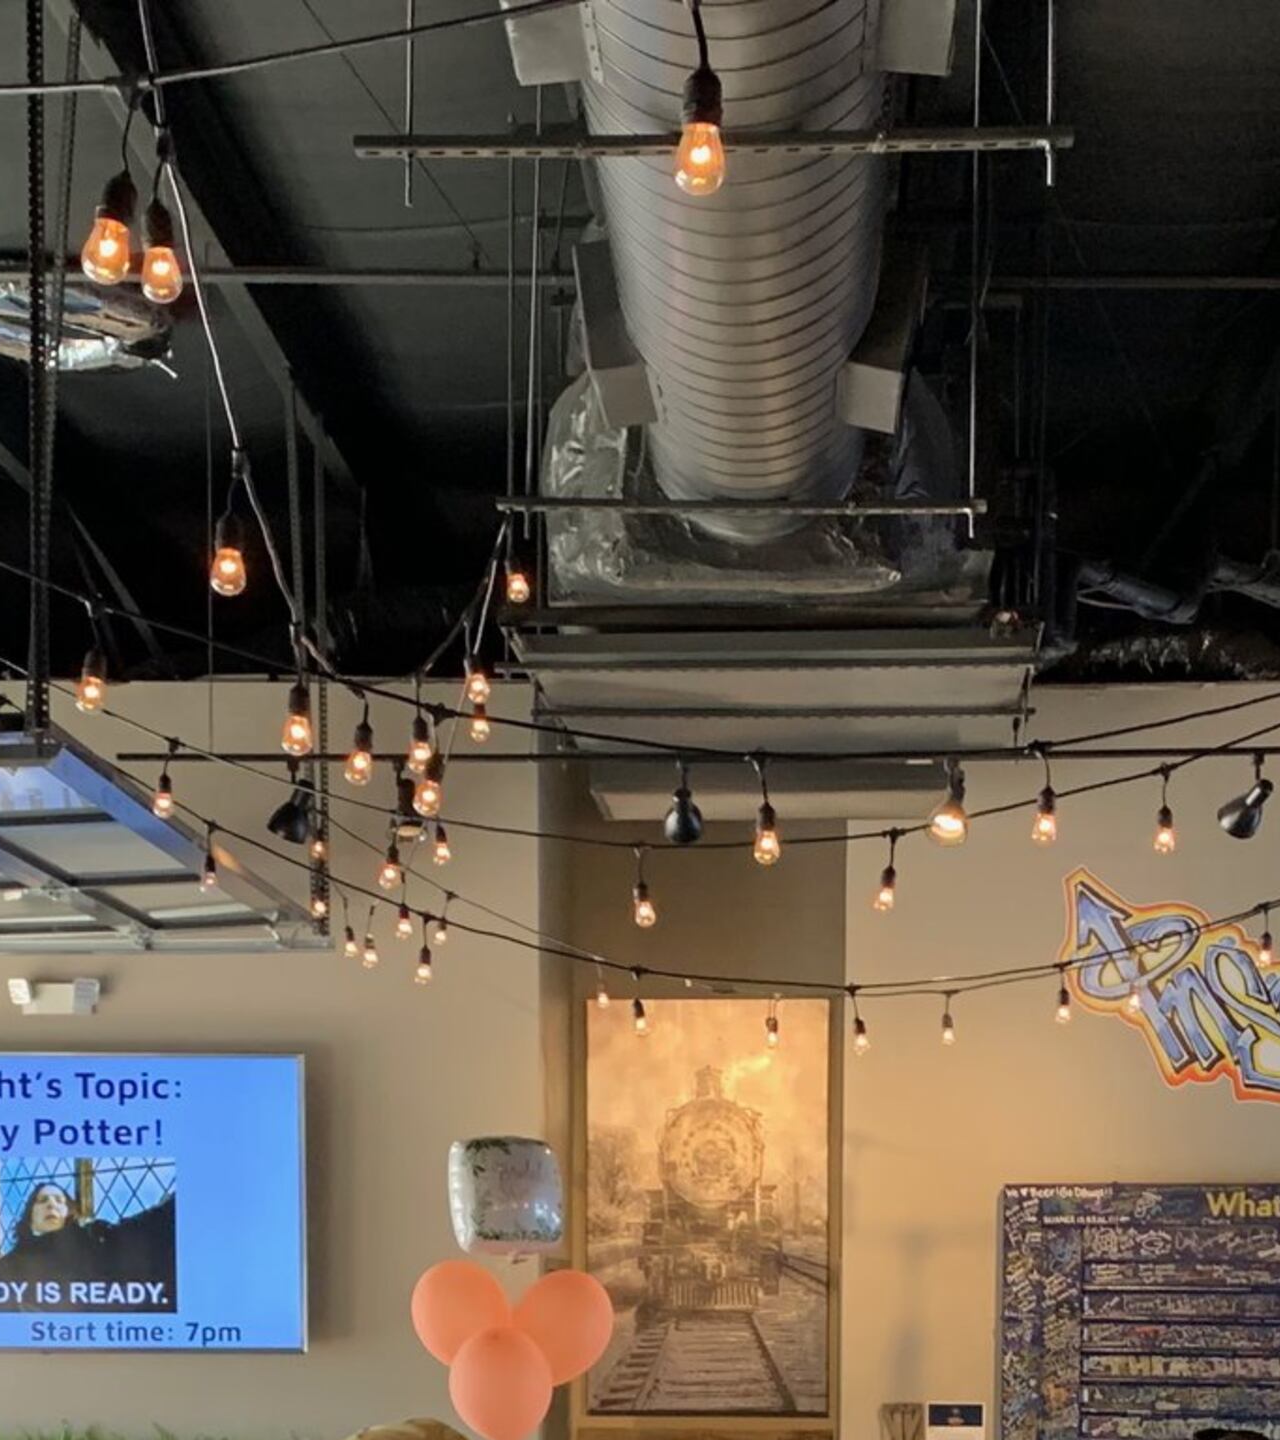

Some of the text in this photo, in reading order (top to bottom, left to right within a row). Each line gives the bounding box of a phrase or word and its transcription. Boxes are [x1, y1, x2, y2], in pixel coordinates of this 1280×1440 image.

[75, 1071, 183, 1106] Topic:
[33, 1117, 163, 1146] Potter!
[36, 1281, 62, 1304] IS
[69, 1281, 169, 1304] READY.
[30, 1320, 242, 1347] Start time: 7pm
